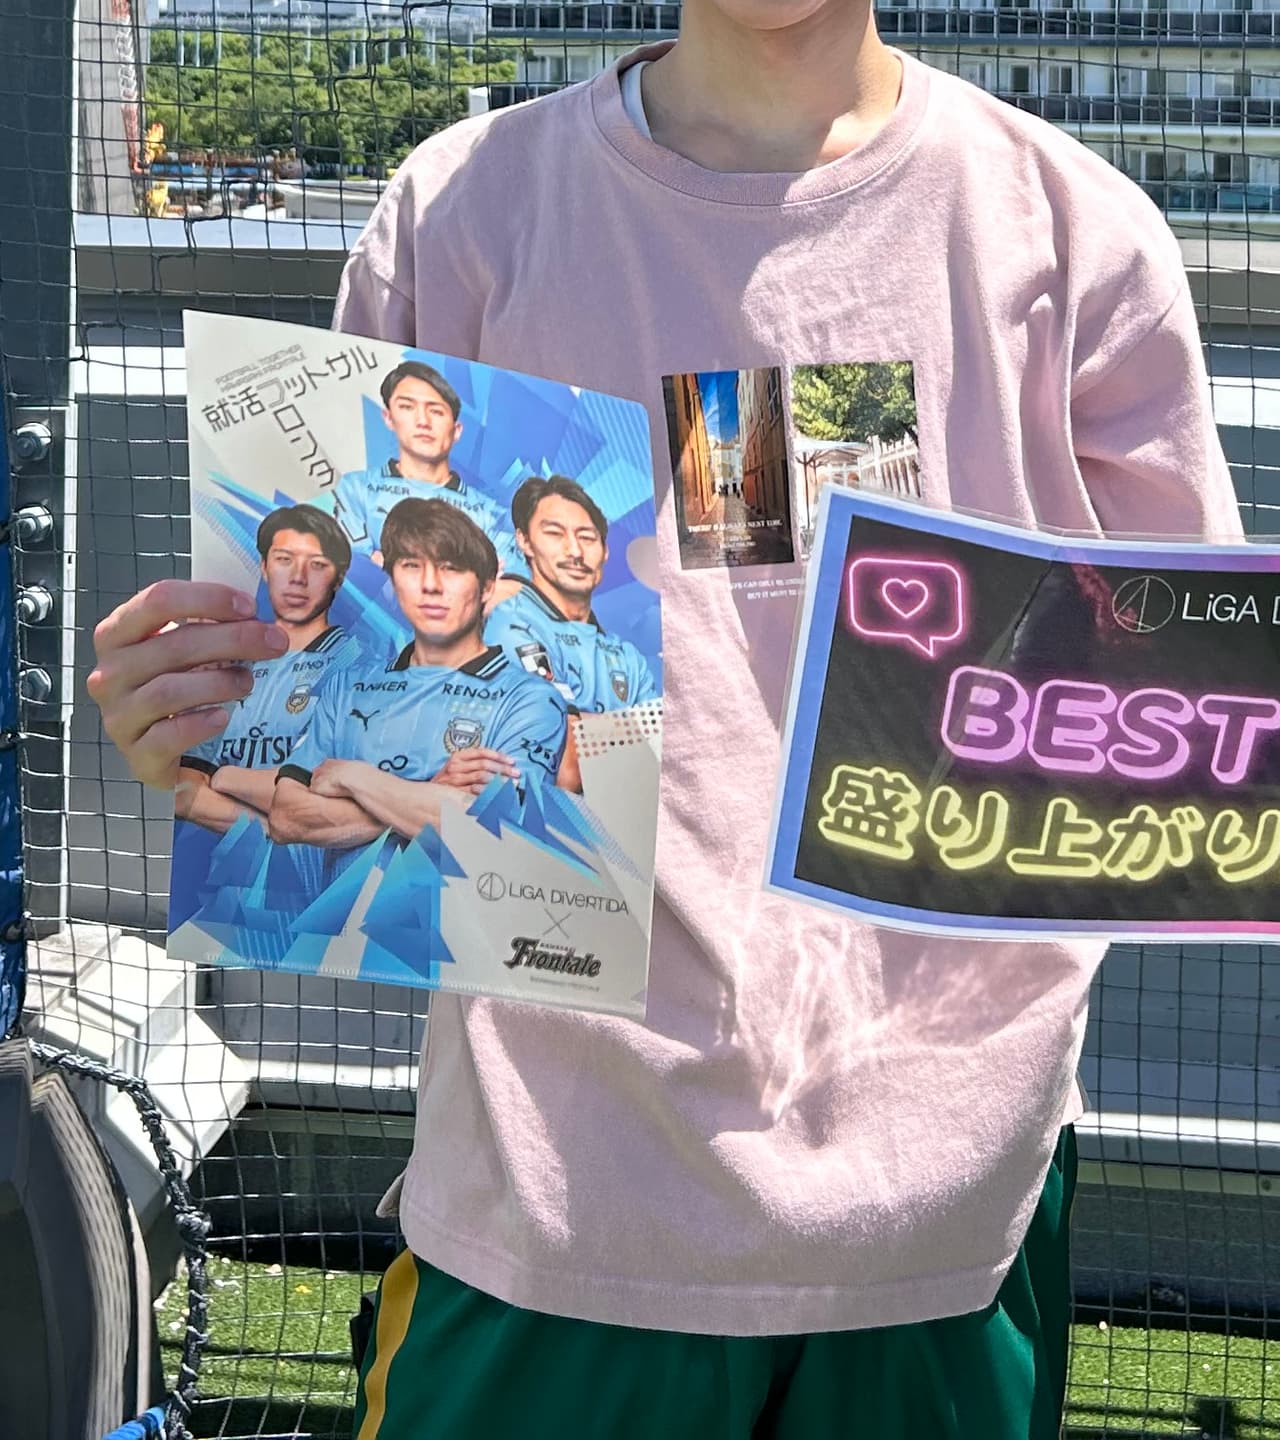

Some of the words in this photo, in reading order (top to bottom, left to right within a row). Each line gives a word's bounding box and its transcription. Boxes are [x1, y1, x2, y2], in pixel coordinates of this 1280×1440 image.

[202, 345, 378, 433] 就活フットサル
[503, 936, 602, 978] Frontale
